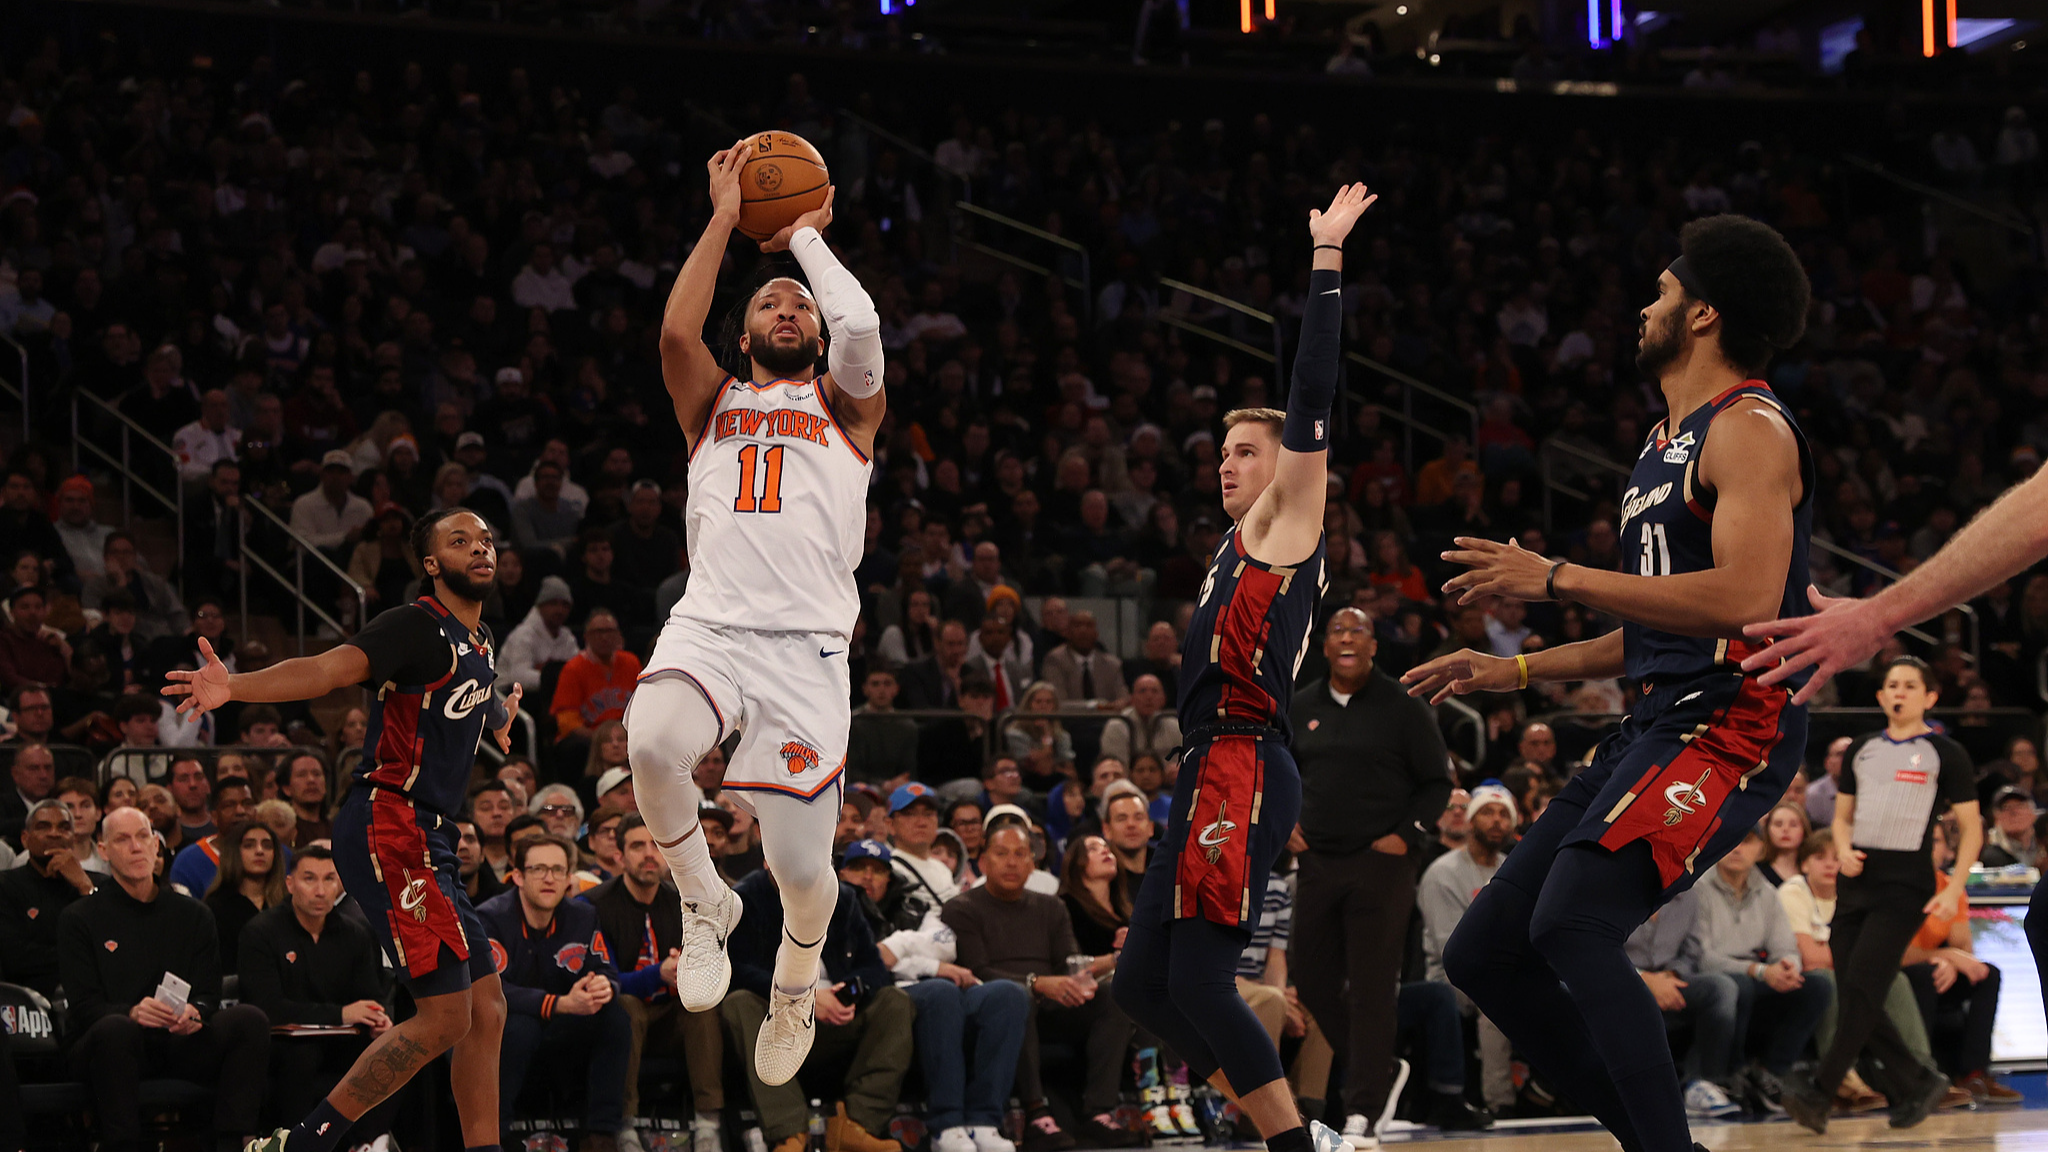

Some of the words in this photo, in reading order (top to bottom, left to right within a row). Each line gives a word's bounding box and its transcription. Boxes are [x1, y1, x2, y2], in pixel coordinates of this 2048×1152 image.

[714, 408, 766, 444] NEW
[766, 408, 829, 448] YORK
[1665, 451, 1687, 461] CLIFFS
[734, 444, 785, 513] 11
[1640, 521, 1671, 577] 31
[780, 741, 818, 767] KNICKS
[18, 1005, 53, 1038] App
